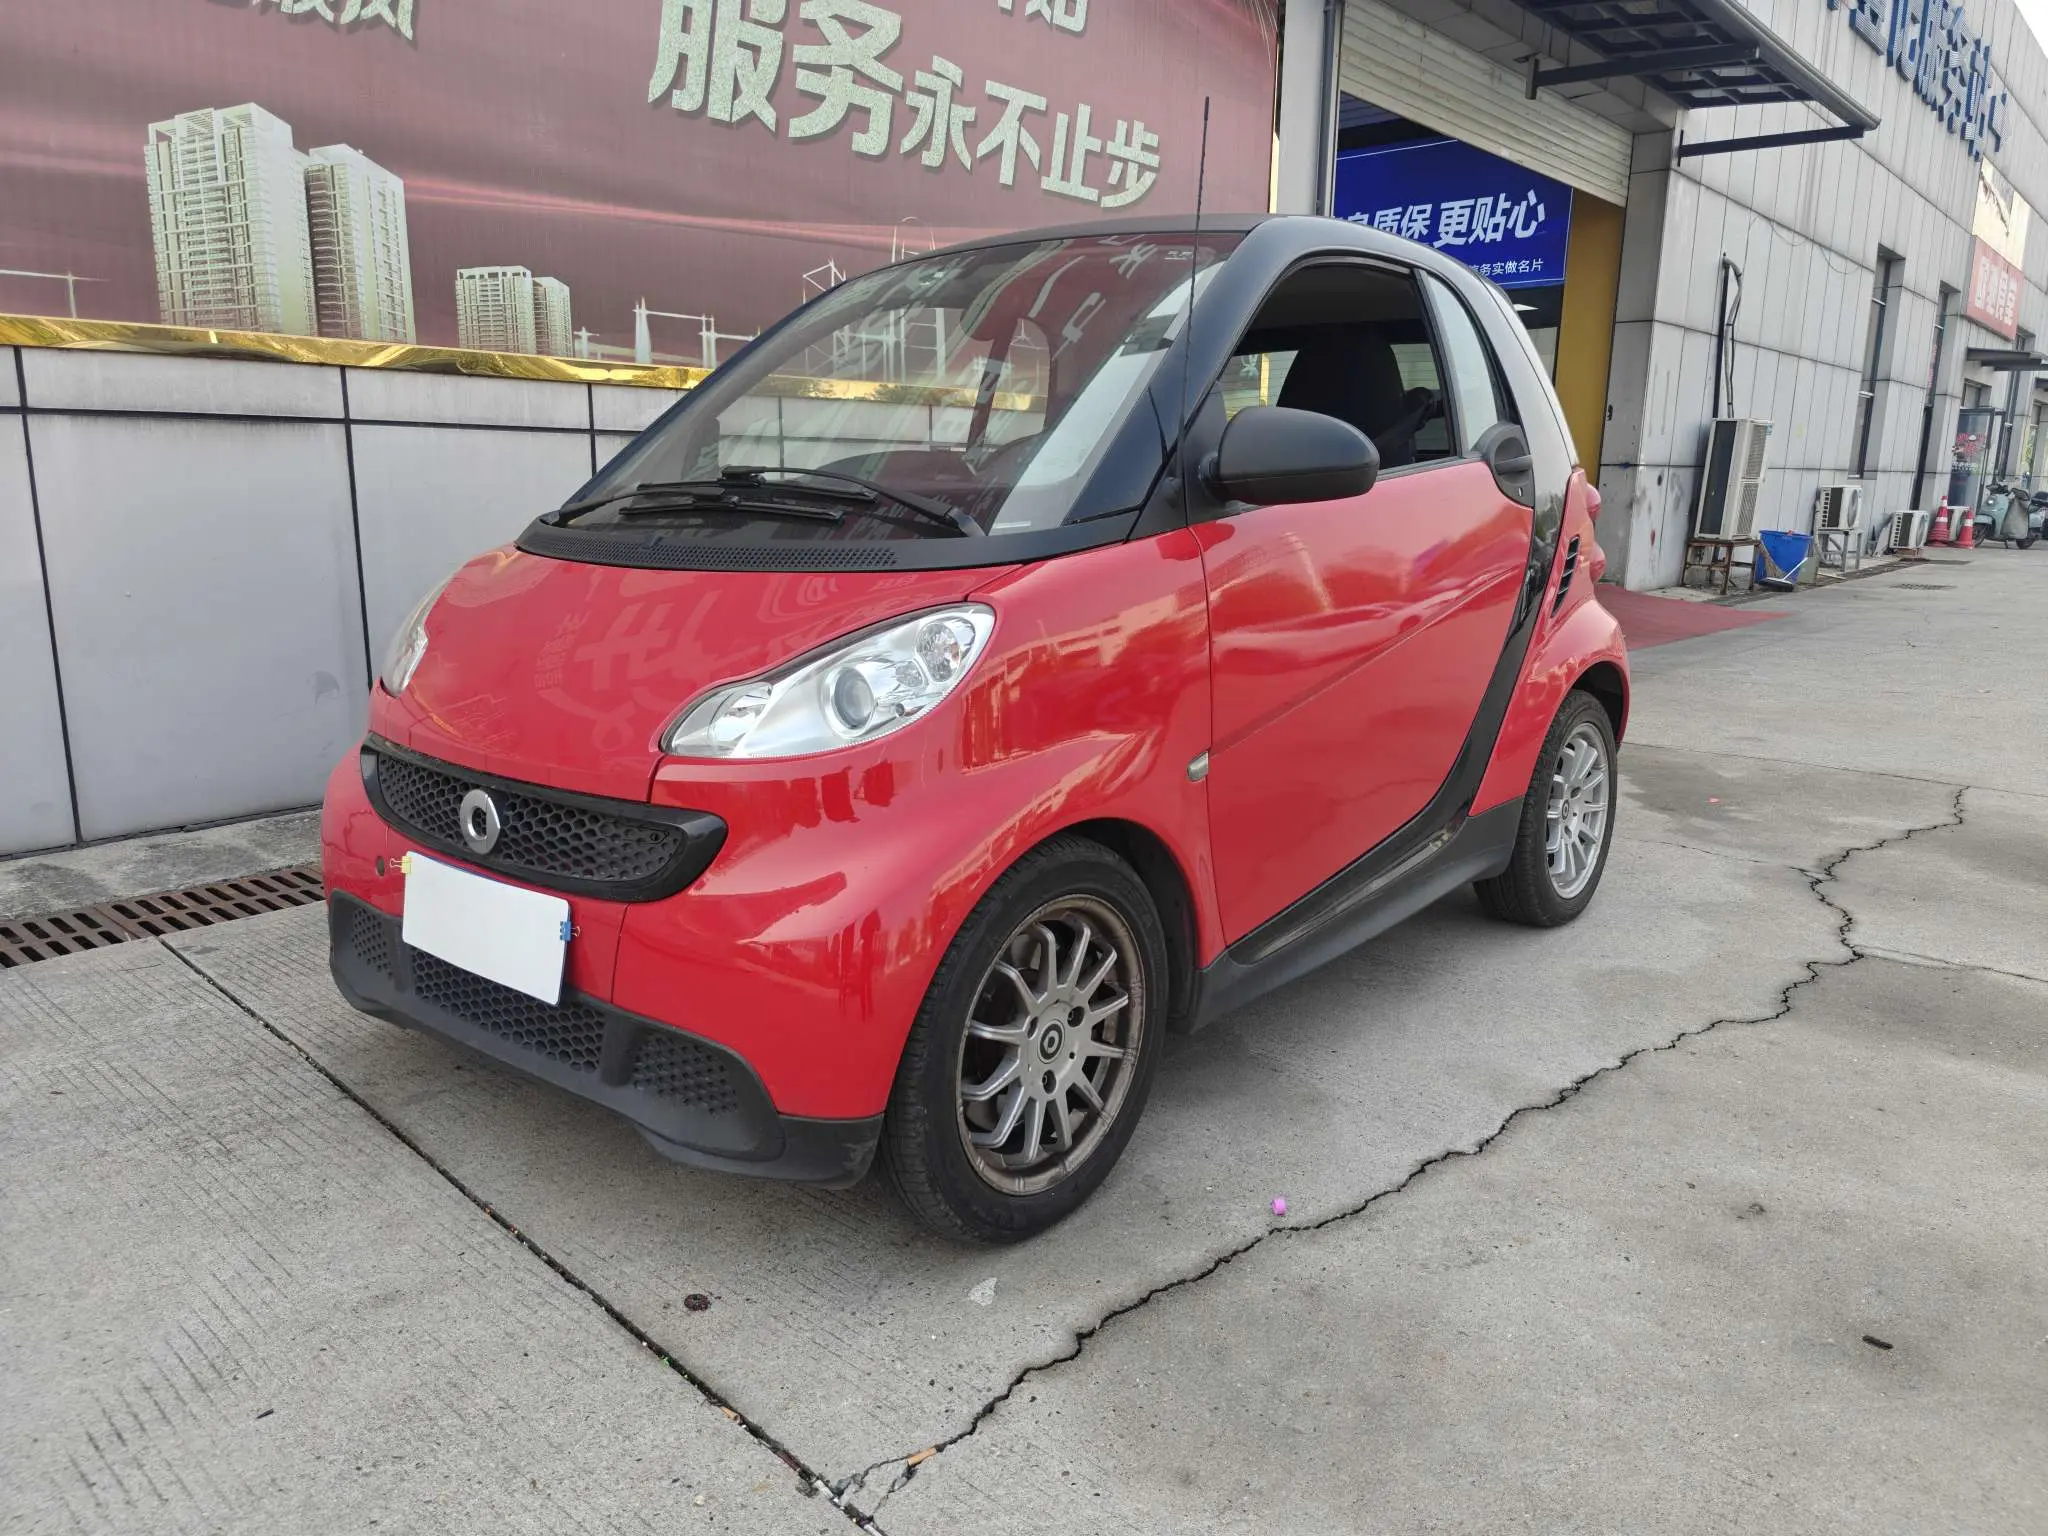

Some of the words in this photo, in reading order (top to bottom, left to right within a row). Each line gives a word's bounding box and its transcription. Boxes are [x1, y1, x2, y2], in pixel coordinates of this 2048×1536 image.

[647, 0, 1160, 208] 服务永不止步
[1336, 203, 1433, 239] 质保
[1433, 189, 1546, 249] 更贴心
